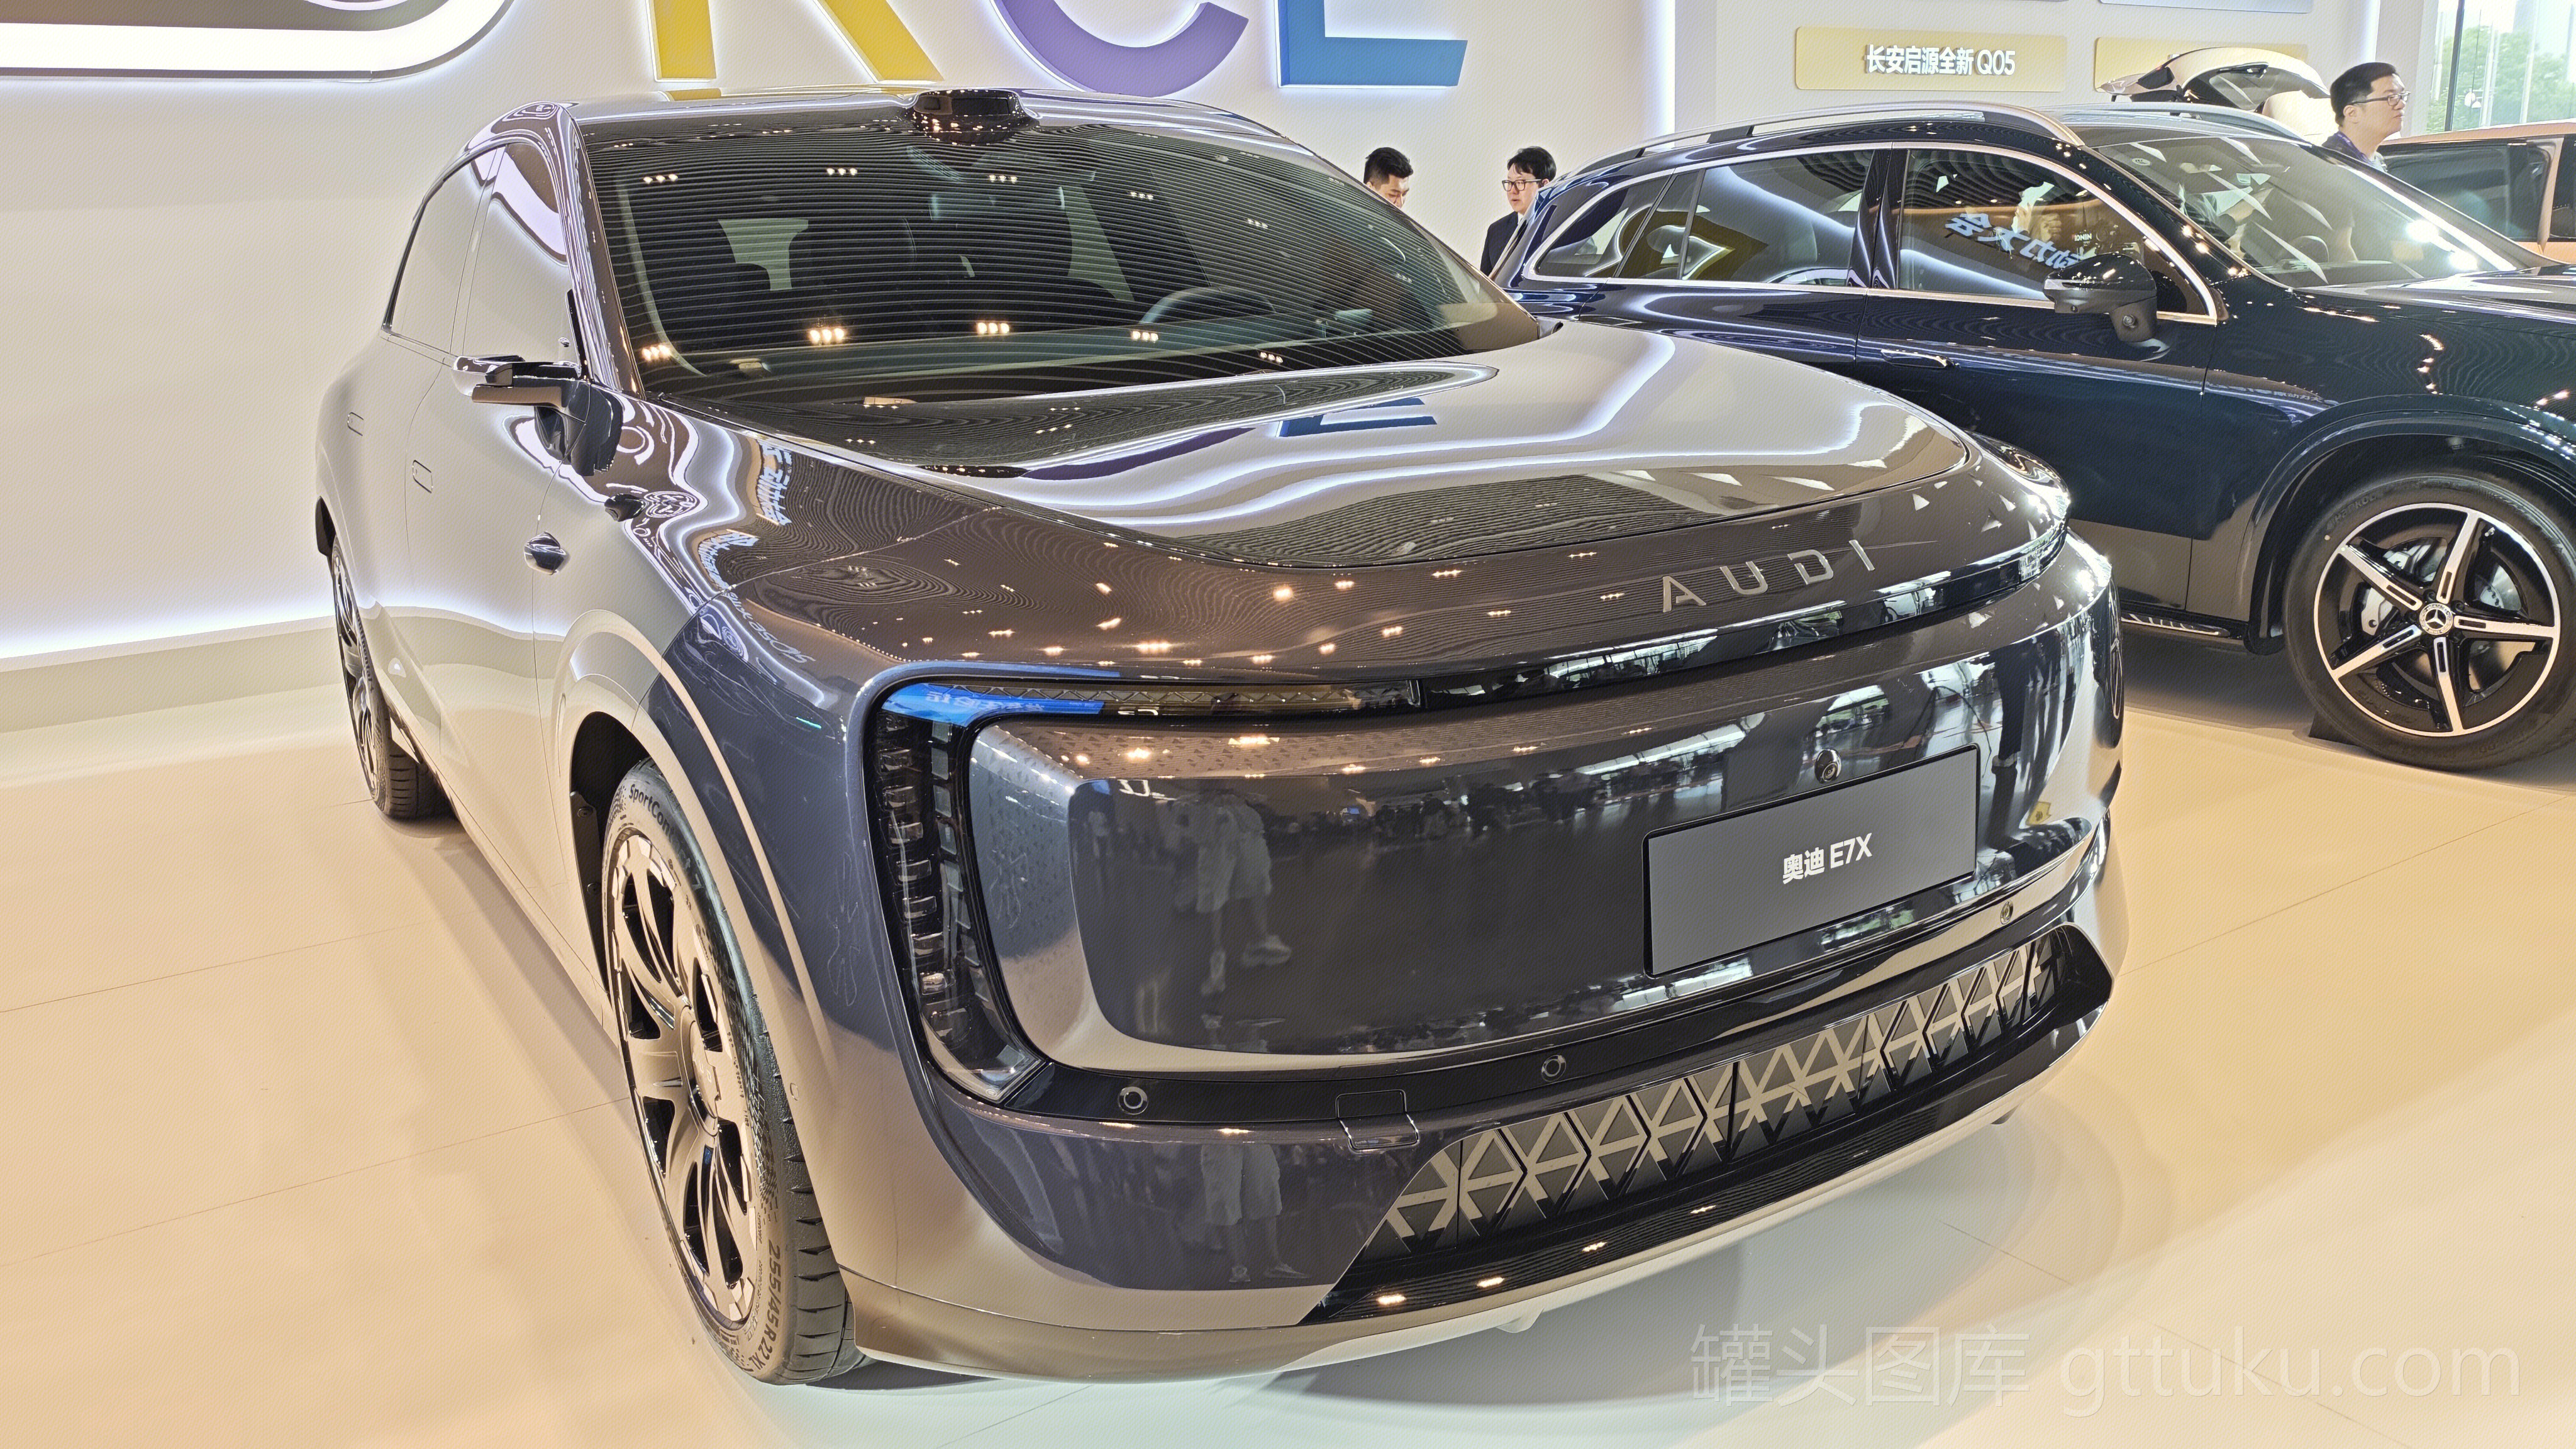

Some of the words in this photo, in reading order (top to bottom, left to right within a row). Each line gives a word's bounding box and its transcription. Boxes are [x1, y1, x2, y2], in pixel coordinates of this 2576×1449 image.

[1866, 44, 1974, 75] 长安启源全新
[1977, 49, 2016, 75] Q05
[1663, 539, 1875, 613] AUDI
[1782, 847, 1825, 885] 奥迪
[1830, 832, 1873, 869] E7X
[765, 1238, 782, 1329] 255/45
